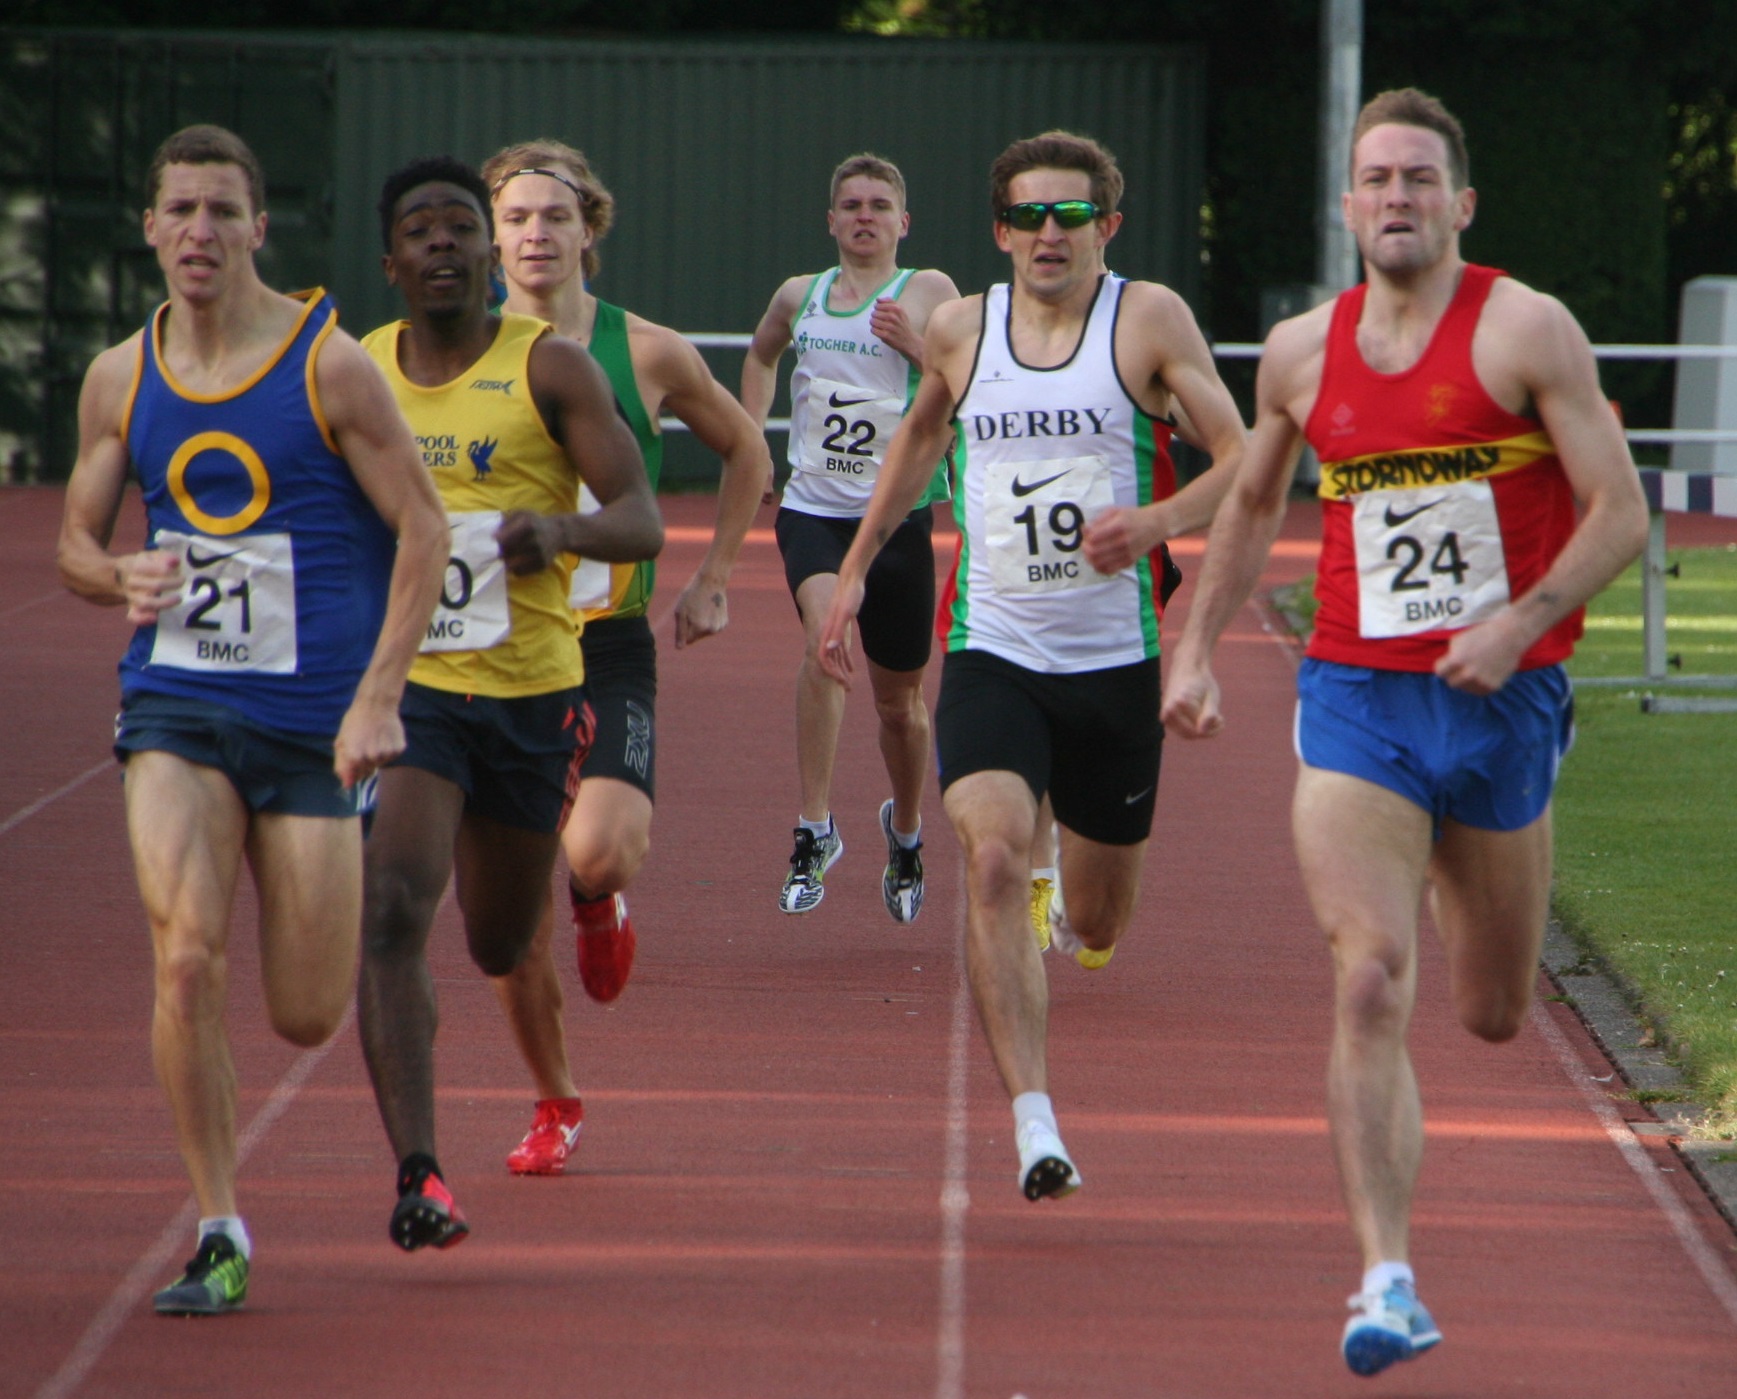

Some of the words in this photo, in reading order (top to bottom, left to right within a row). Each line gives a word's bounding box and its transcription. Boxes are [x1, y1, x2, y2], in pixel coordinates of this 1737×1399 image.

[809, 338, 856, 353] TOGHER
[859, 343, 882, 357] A.C.
[821, 413, 876, 457] 22
[974, 408, 1112, 441] DERBY
[415, 435, 460, 450] POOL
[422, 452, 456, 467] ERS
[826, 457, 864, 474] BMC
[1331, 446, 1499, 496] STORNOWAY
[1013, 501, 1085, 556] 19
[1027, 561, 1079, 582] BMC
[1386, 531, 1469, 593] 24
[440, 557, 473, 610] 0
[185, 576, 251, 633] 21
[1405, 597, 1463, 621] BMC
[427, 619, 464, 639] MC
[197, 640, 249, 662] BMC
